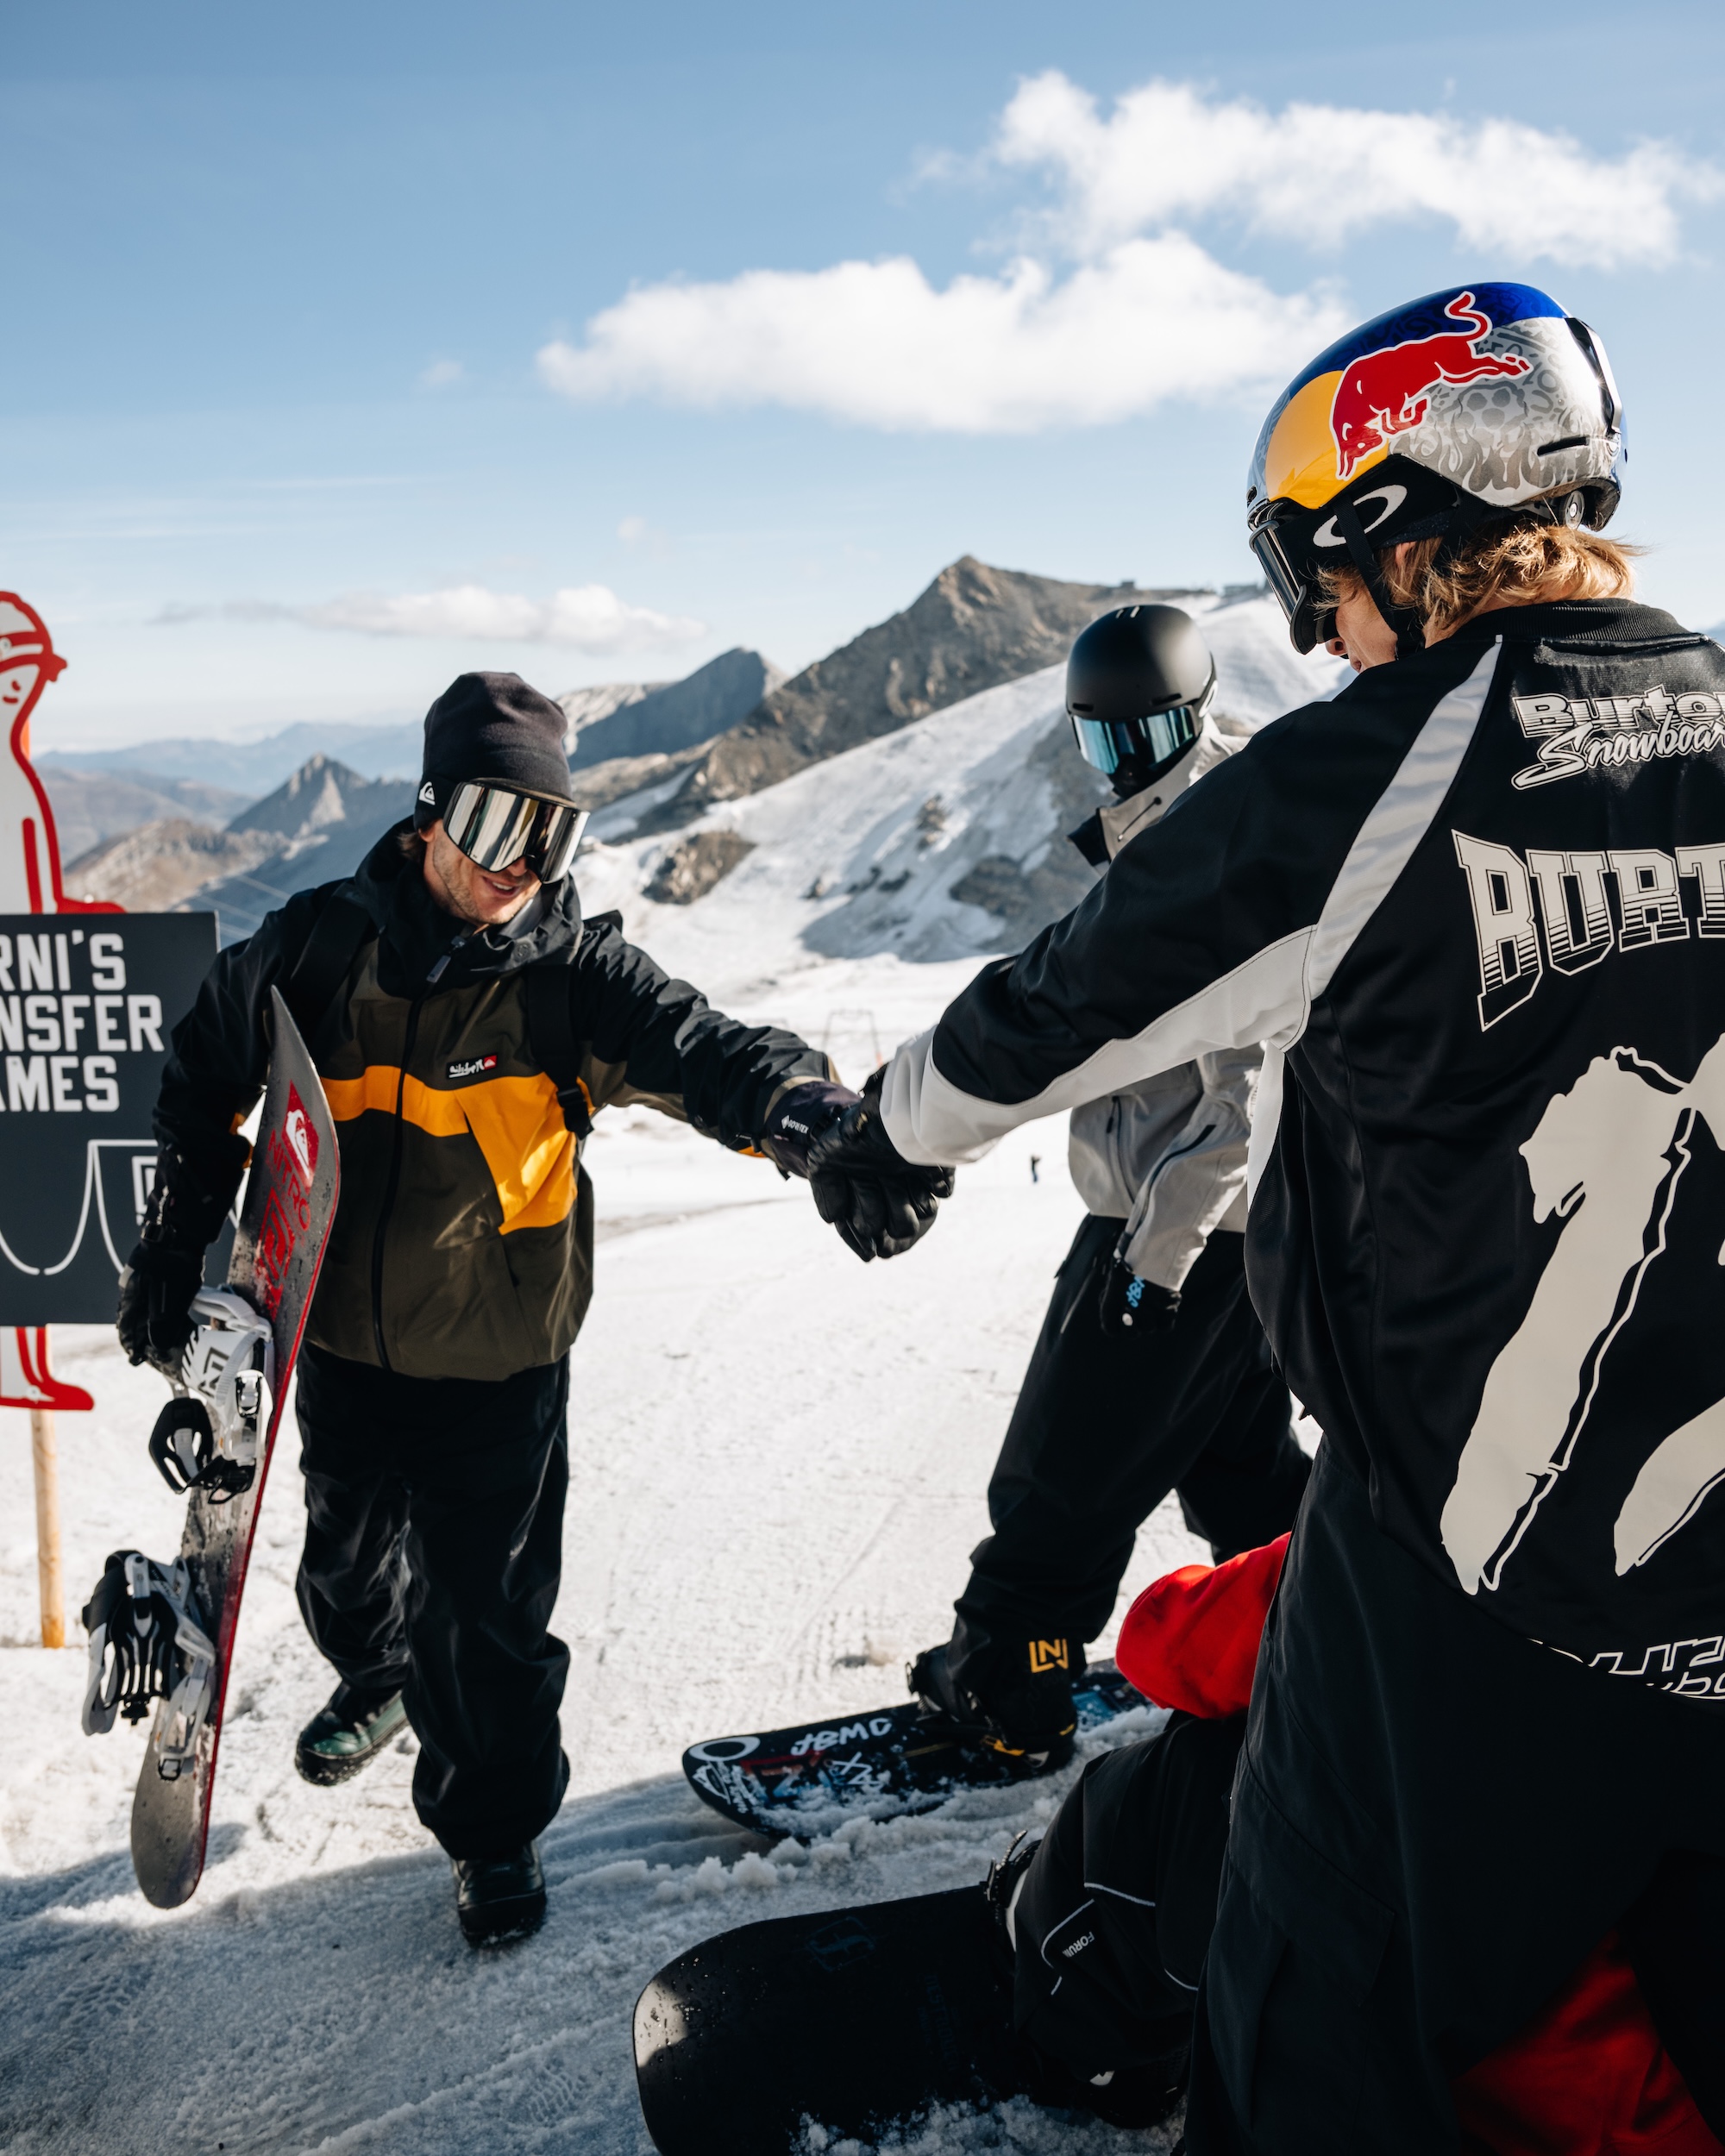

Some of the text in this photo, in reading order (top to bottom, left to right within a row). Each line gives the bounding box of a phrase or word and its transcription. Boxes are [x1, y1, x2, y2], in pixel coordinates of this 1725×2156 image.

[1512, 683, 1725, 738] Burto
[1451, 829, 1725, 1033] BURT
[0, 1055, 120, 1112] MES
[265, 1128, 311, 1232] NITRO
